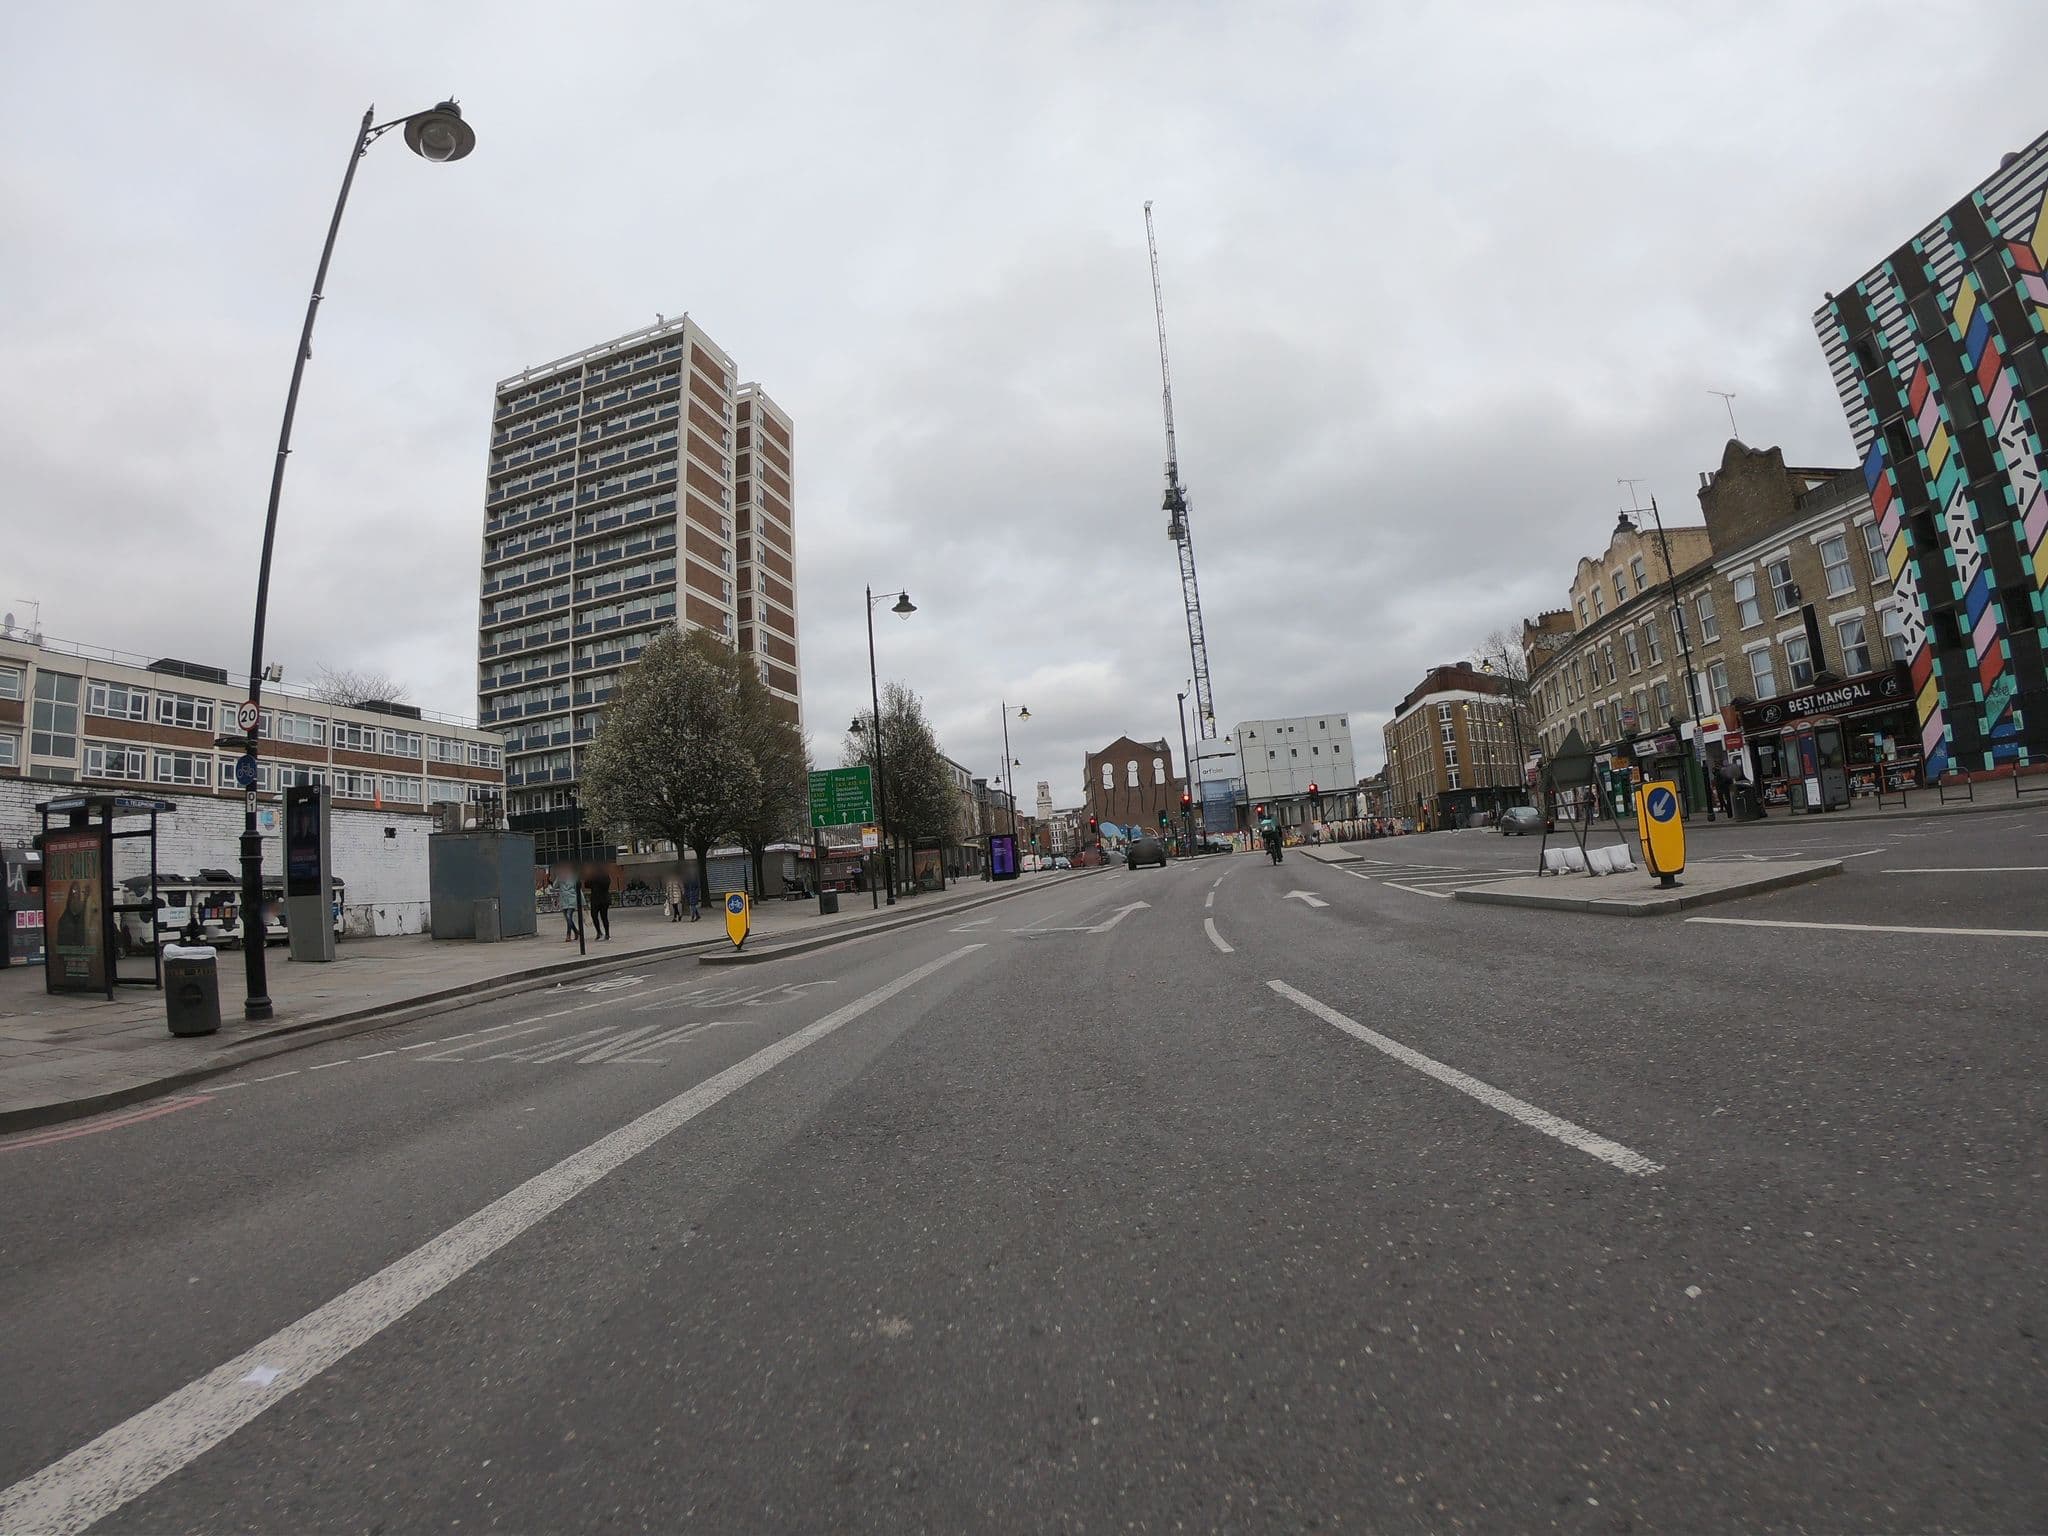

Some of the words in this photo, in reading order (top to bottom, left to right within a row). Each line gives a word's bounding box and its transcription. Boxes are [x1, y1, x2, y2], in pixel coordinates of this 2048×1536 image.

[1788, 695, 1814, 713] BEST
[1816, 683, 1871, 707] MANGAL
[1819, 700, 1854, 713] RESTAURANT
[241, 709, 256, 723] 20
[632, 980, 837, 1011] BUS
[415, 1021, 754, 1064] LANE
